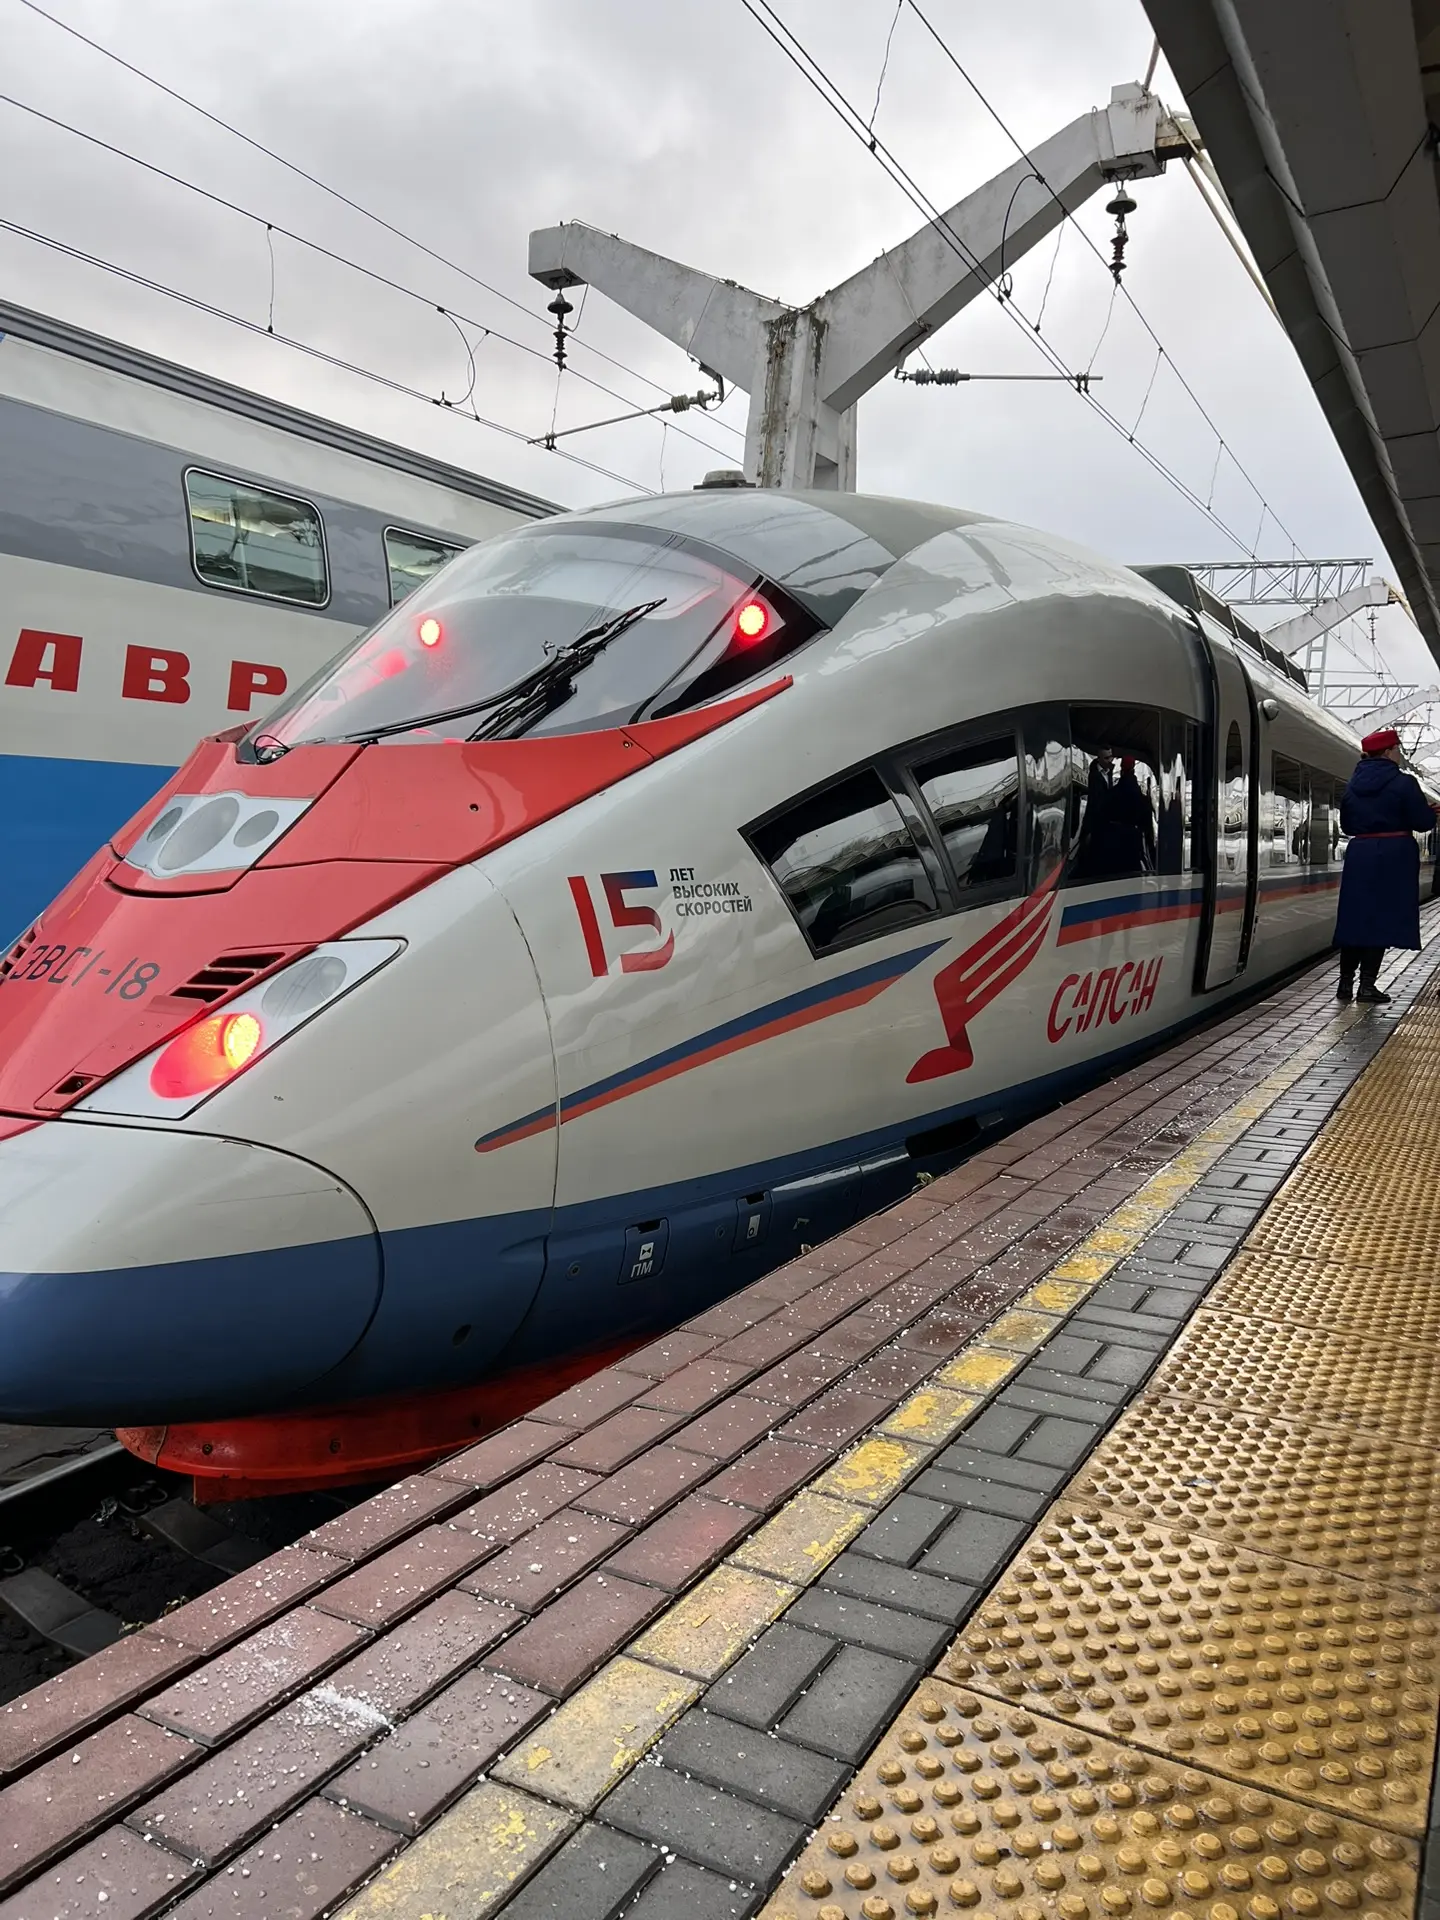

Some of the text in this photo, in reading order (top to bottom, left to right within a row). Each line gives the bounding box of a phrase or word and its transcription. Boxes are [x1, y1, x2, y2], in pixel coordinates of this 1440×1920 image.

[670, 868, 694, 882] ЛЕТ
[673, 883, 740, 900] ВЫСОКИХ
[676, 896, 752, 917] СКОРОСТЕЙ
[567, 869, 675, 977] 15
[1047, 956, 1164, 1043] САПСАН
[631, 1260, 653, 1278] ПМ
